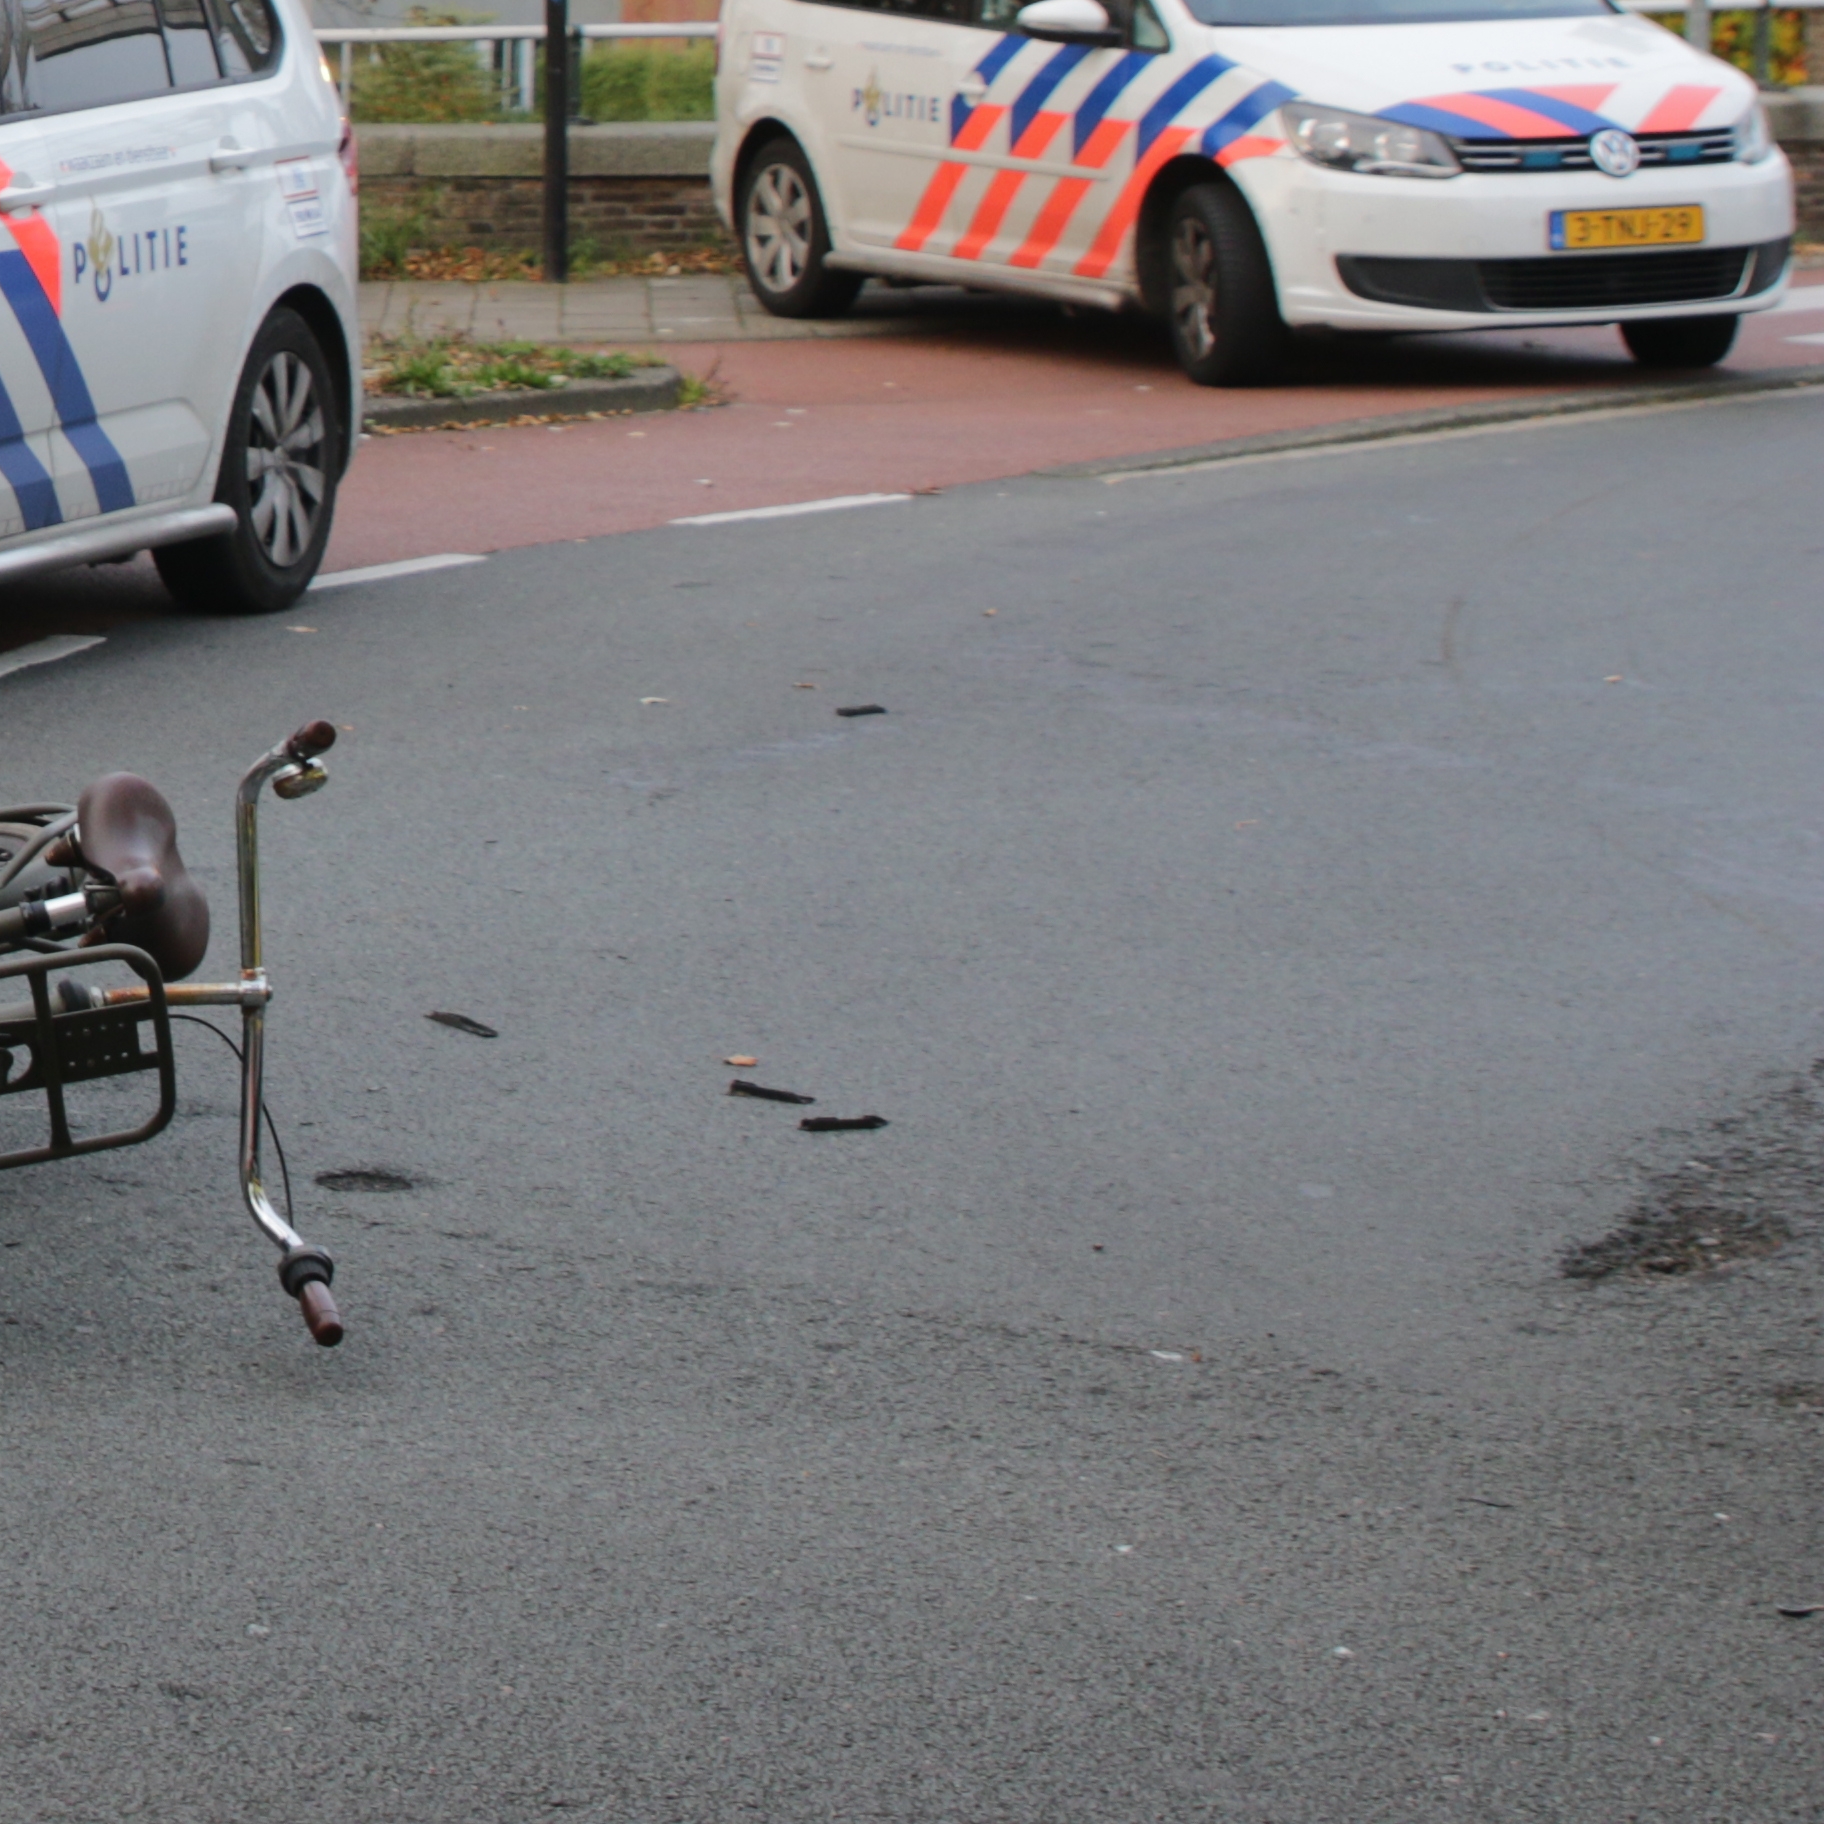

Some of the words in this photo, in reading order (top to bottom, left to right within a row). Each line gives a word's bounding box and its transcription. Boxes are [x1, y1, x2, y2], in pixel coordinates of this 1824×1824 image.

[1451, 56, 1633, 75] POLITIE
[851, 87, 943, 127] POLITIE
[74, 226, 189, 302] POLITIE
